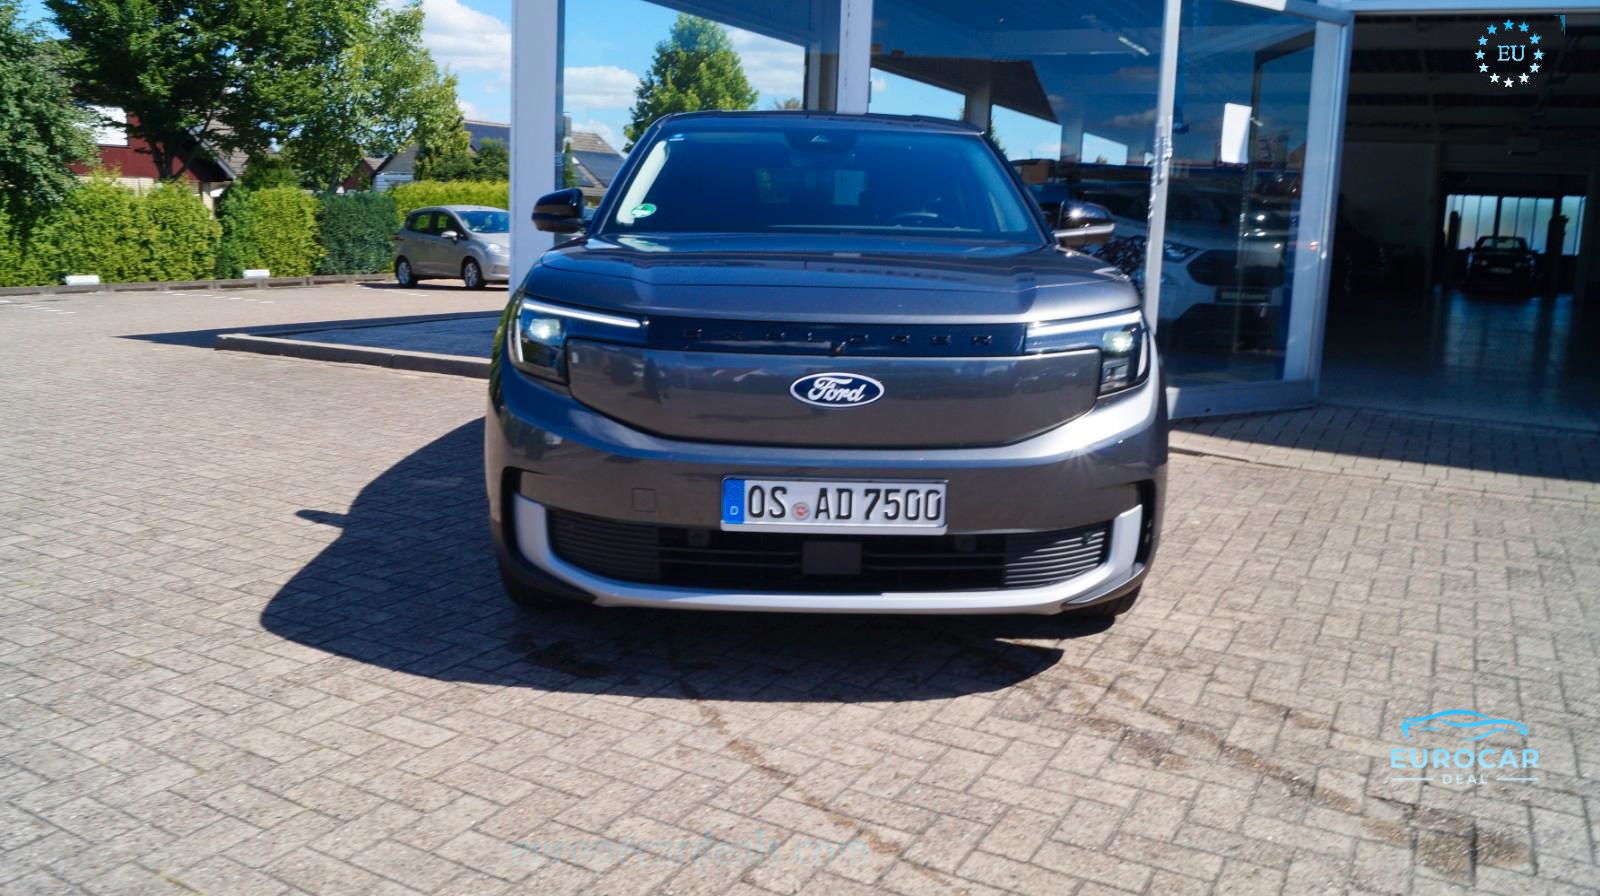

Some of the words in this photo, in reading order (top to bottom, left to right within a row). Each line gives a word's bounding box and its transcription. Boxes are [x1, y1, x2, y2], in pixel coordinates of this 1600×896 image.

[807, 376, 867, 402] Ford
[748, 485, 787, 519] OS
[814, 487, 853, 520] AD
[863, 488, 942, 521] 7500
